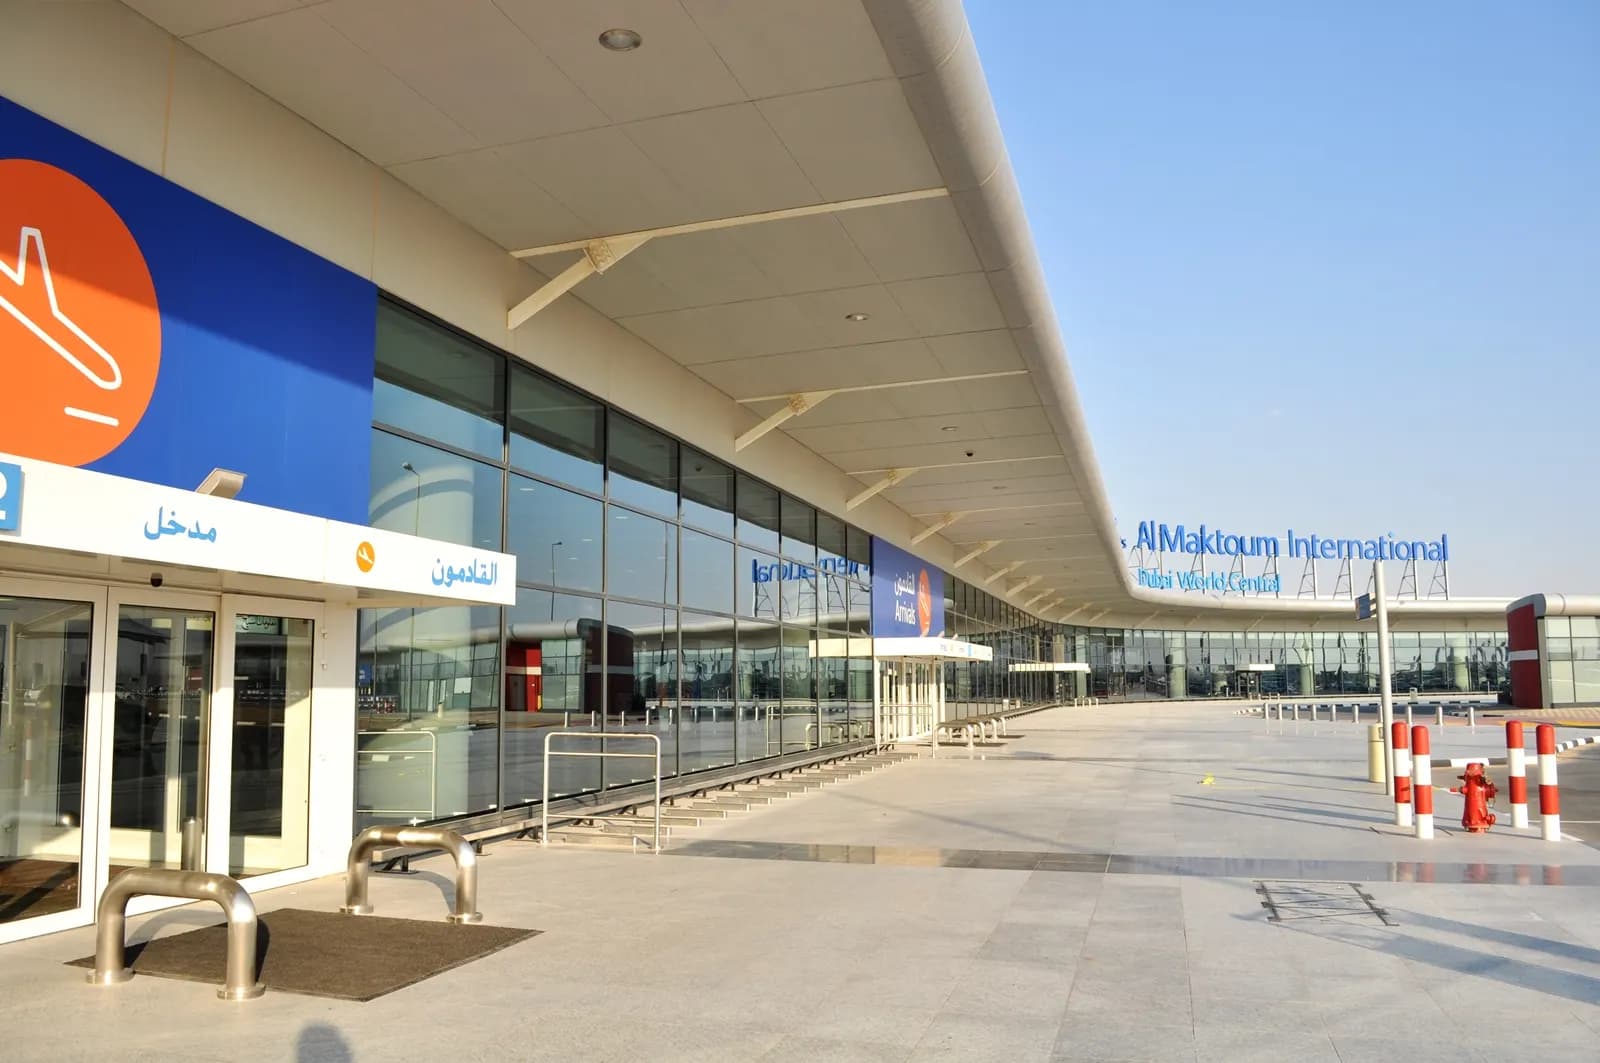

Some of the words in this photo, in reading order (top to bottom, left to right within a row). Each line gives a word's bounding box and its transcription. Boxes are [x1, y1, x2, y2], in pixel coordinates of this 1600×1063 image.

[144, 505, 217, 543] مدخل
[1287, 528, 1449, 561] International
[431, 558, 497, 588] القادمون
[1137, 567, 1173, 589] Dubai
[1176, 570, 1226, 591] World
[1228, 571, 1282, 592] Central
[895, 599, 916, 625] Arrivals
